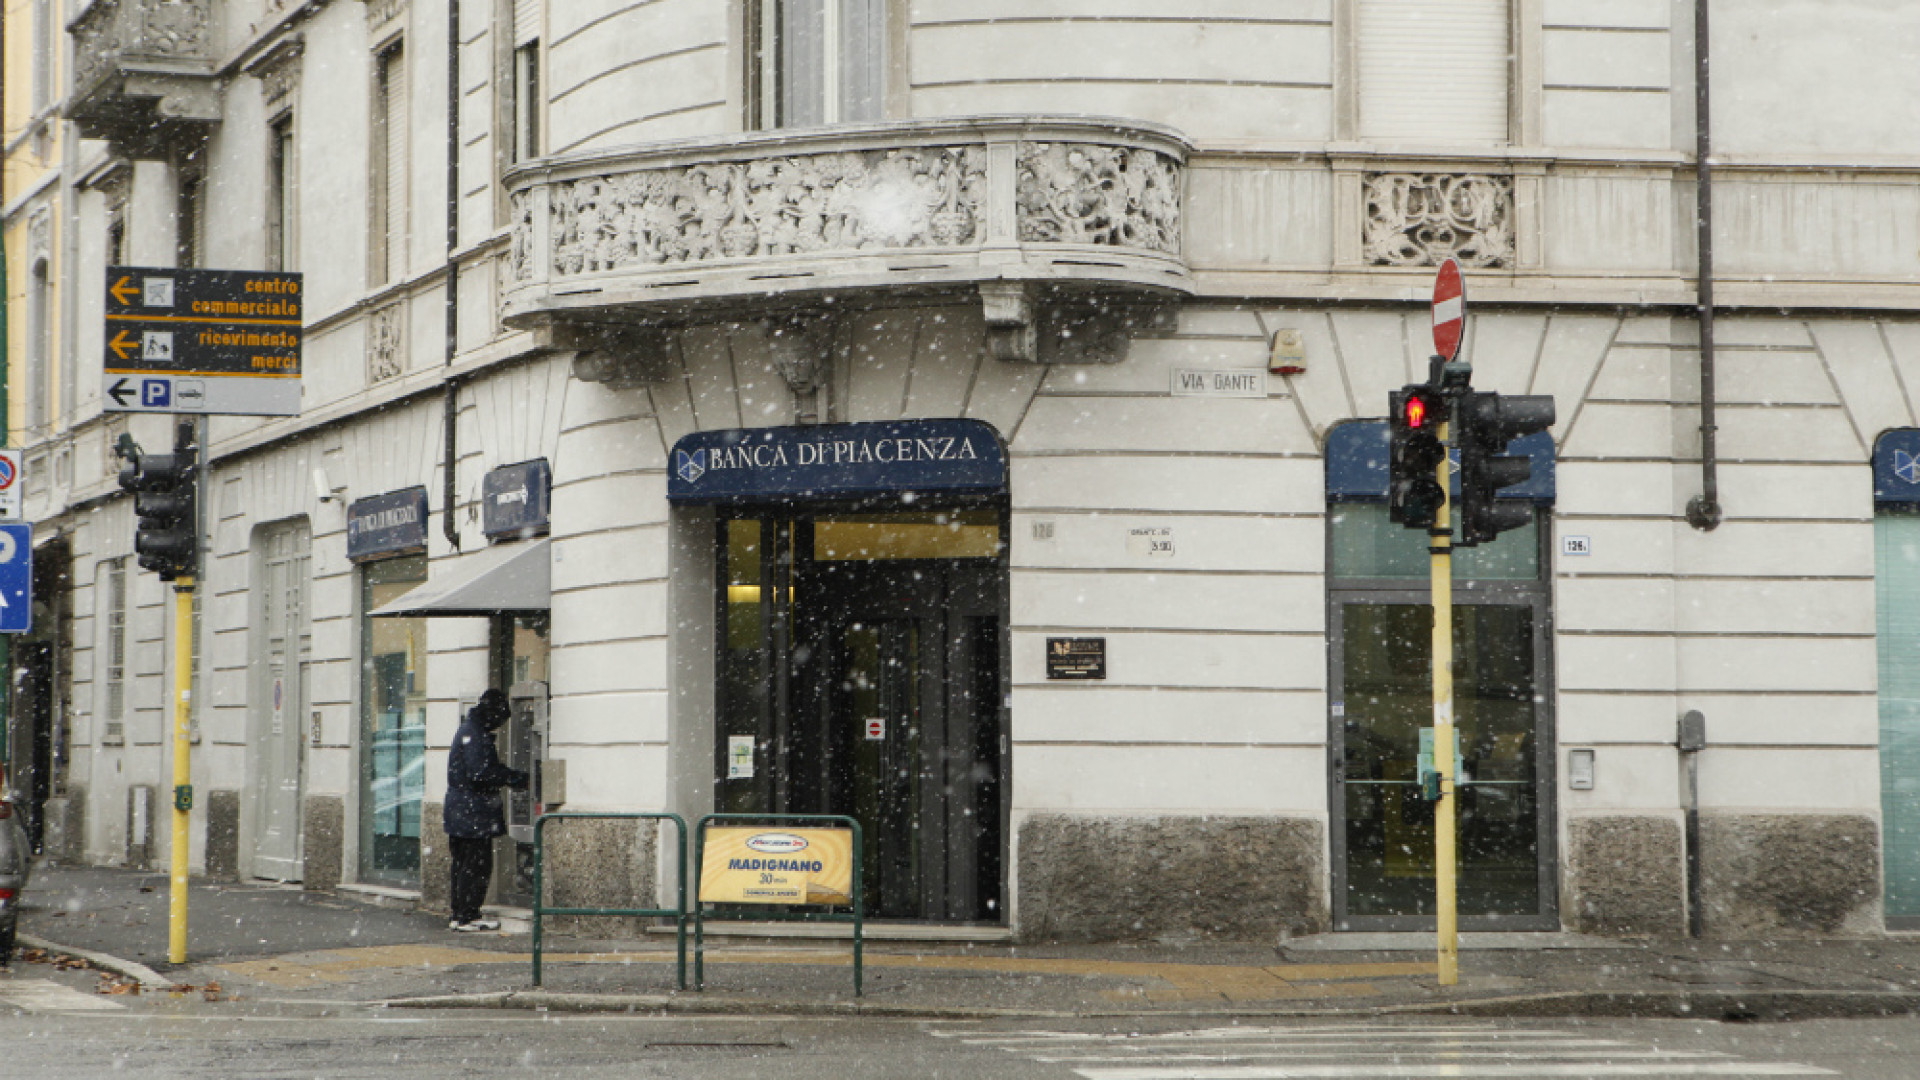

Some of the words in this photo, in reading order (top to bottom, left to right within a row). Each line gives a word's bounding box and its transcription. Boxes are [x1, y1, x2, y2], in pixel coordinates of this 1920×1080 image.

[245, 278, 298, 294] centro
[191, 299, 297, 316] commerciale
[200, 328, 297, 347] ricevimento
[251, 353, 297, 369] merci
[1181, 374, 1204, 390] VIA
[147, 382, 166, 404] P
[710, 444, 788, 470] BANCA
[797, 442, 825, 465] DI
[833, 436, 977, 462] PIACENZA
[728, 858, 822, 872] MADIGNANO
[759, 872, 772, 884] 30
